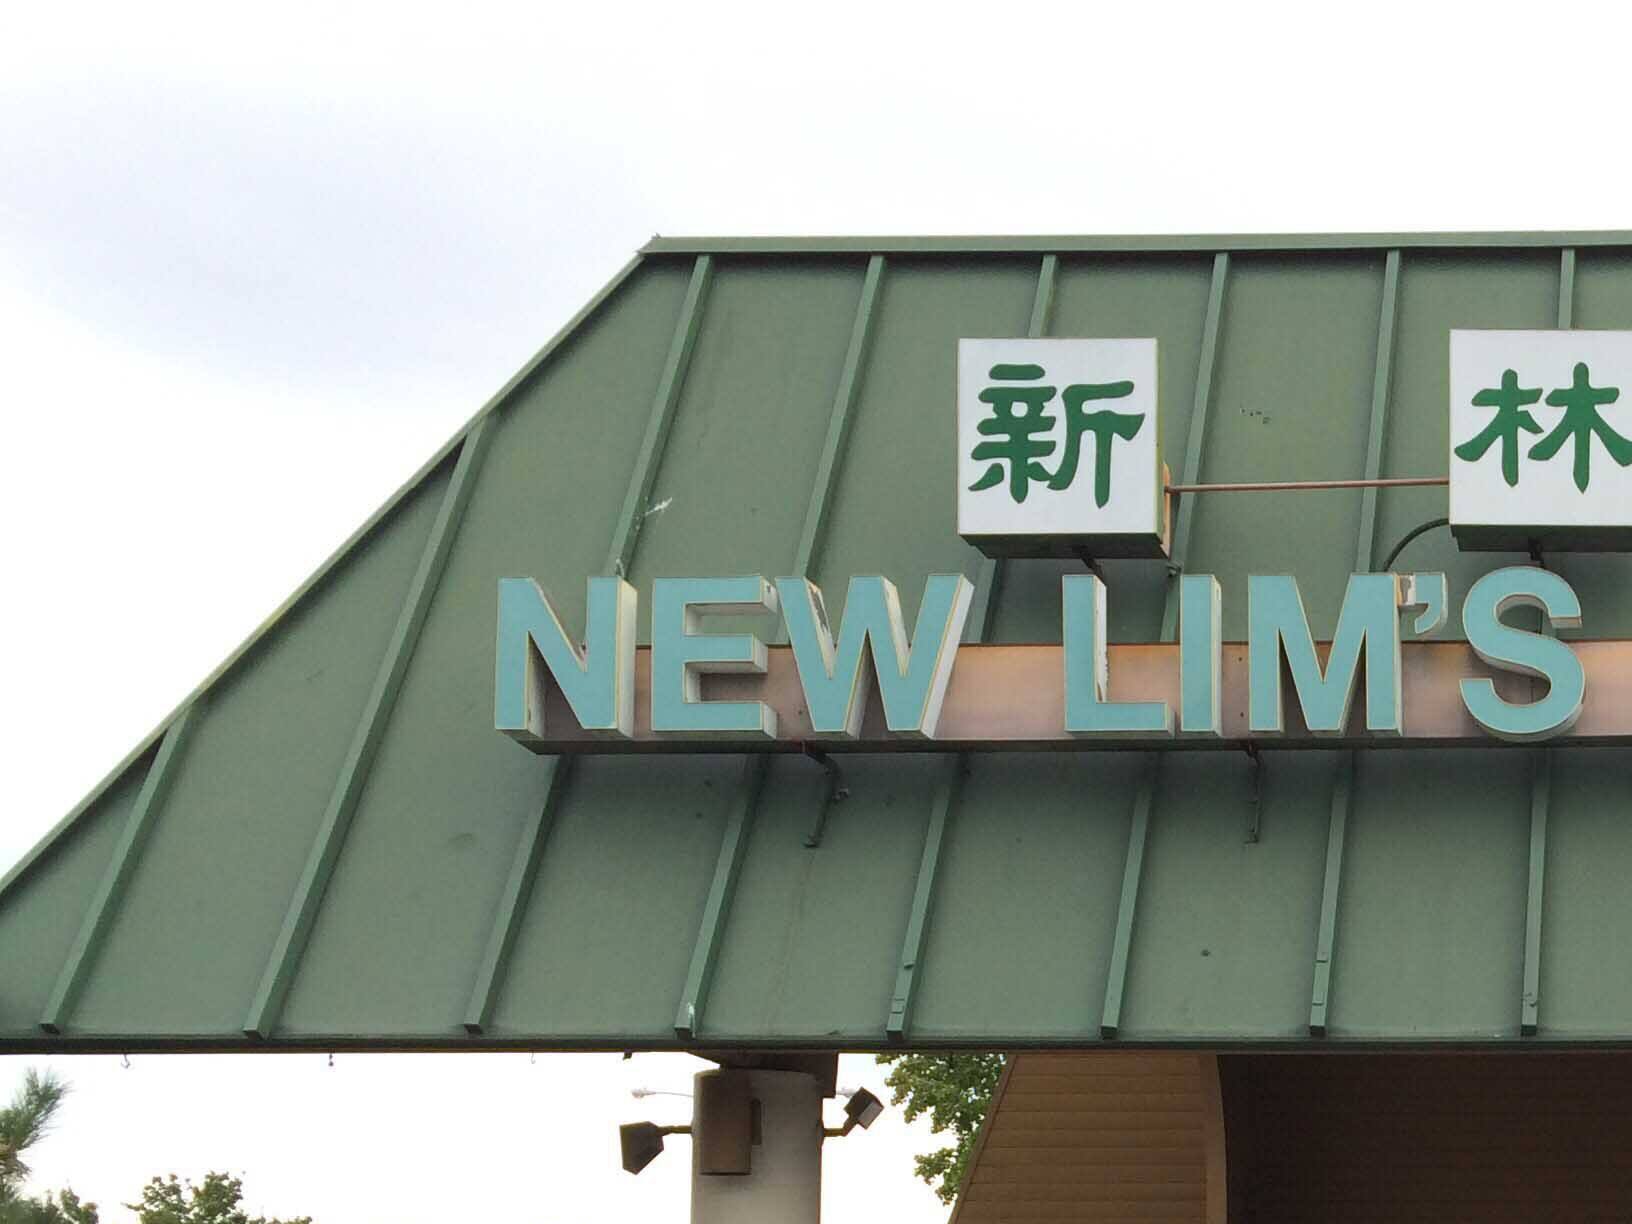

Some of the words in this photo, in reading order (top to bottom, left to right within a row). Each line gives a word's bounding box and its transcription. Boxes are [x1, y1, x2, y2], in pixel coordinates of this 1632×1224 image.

[968, 364, 1146, 508] 新
[495, 573, 974, 740] NEW
[1063, 567, 1586, 741] LIM'S
